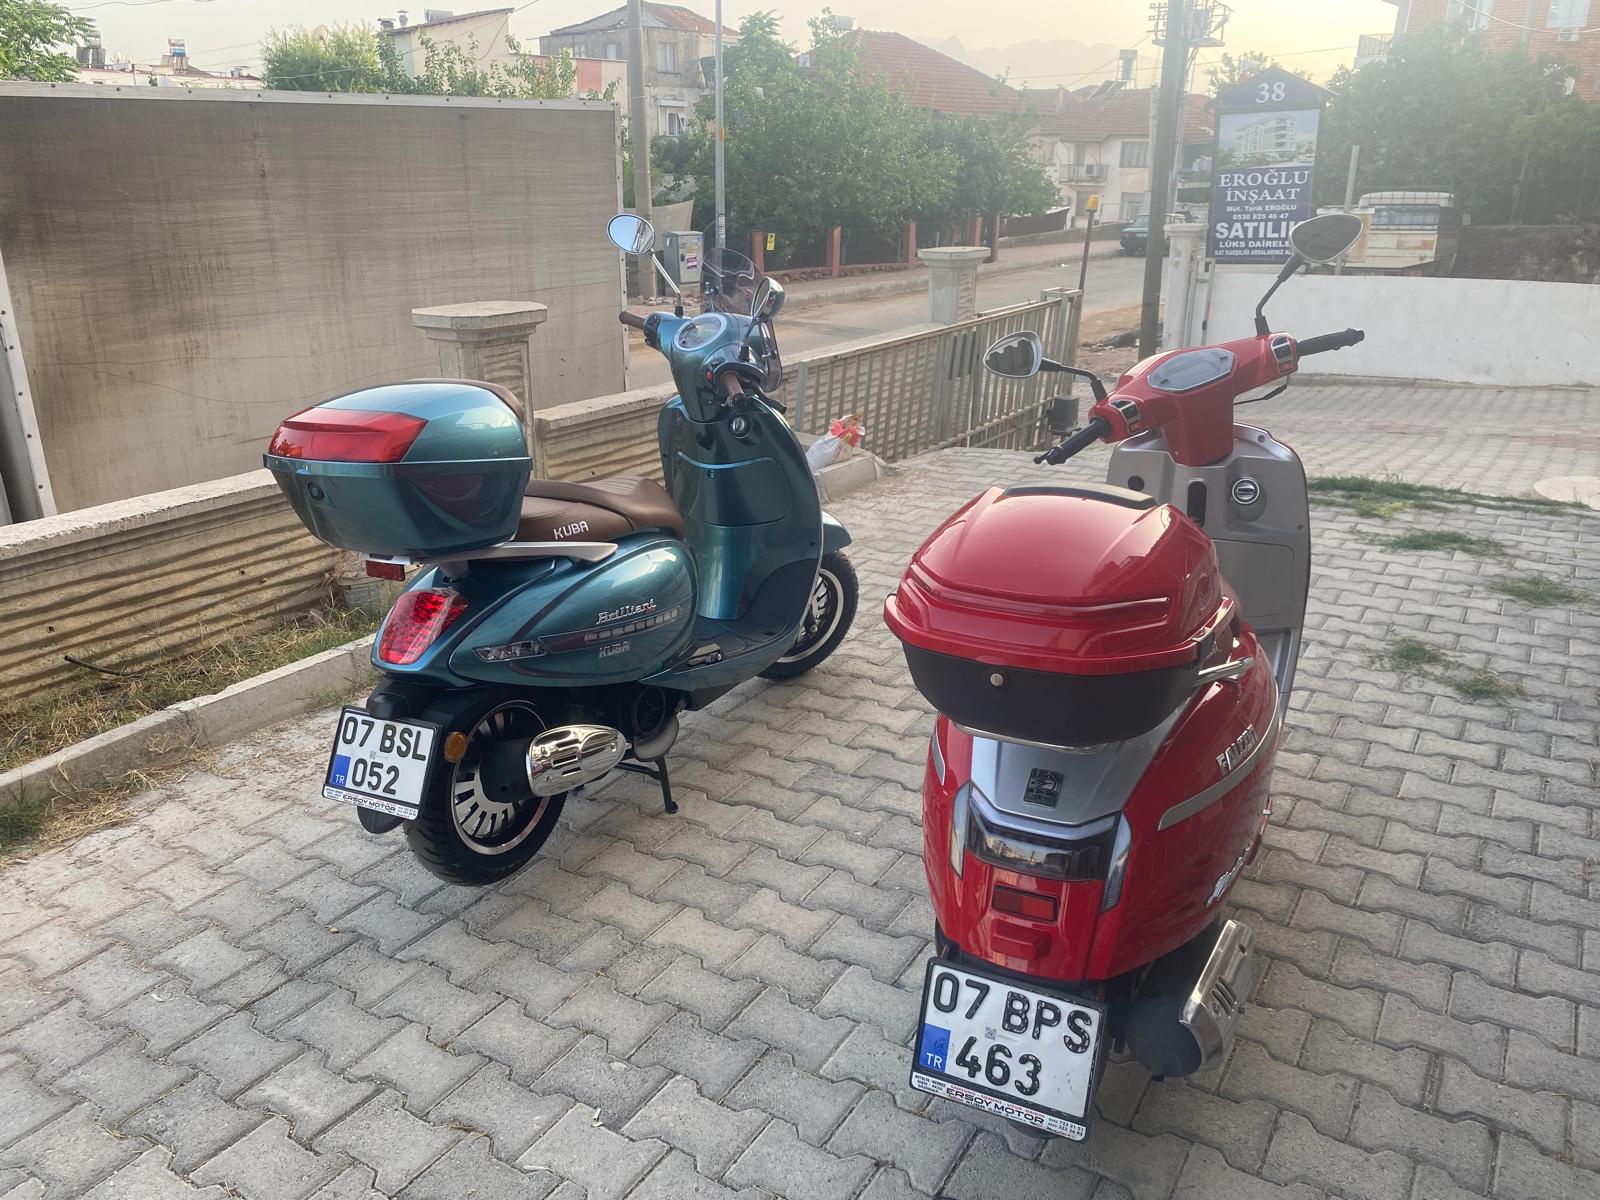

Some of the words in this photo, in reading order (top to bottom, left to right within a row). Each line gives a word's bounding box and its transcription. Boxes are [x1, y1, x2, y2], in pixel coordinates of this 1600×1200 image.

[1256, 82, 1286, 103] 38
[1218, 169, 1310, 188] EROĞLU
[1225, 188, 1301, 204] İNŞAAT
[1265, 203, 1298, 211] EROĞLU
[1219, 240, 1246, 248] LÜKS
[1248, 239, 1291, 248] DAİRELE
[553, 520, 589, 540] KUBA
[599, 641, 631, 658] KUBA
[342, 716, 375, 748] 07
[379, 723, 426, 762] BSL
[335, 774, 345, 785] TR
[351, 758, 400, 796] 052
[343, 793, 368, 806] ERSOY
[368, 800, 396, 813] MOTOR
[933, 971, 990, 1020] 07
[1001, 990, 1092, 1055] BPS
[926, 1052, 942, 1069] TR
[955, 1036, 1042, 1096] 463
[946, 1087, 993, 1108] ERSOY
[994, 1103, 1045, 1125] MOTOR
